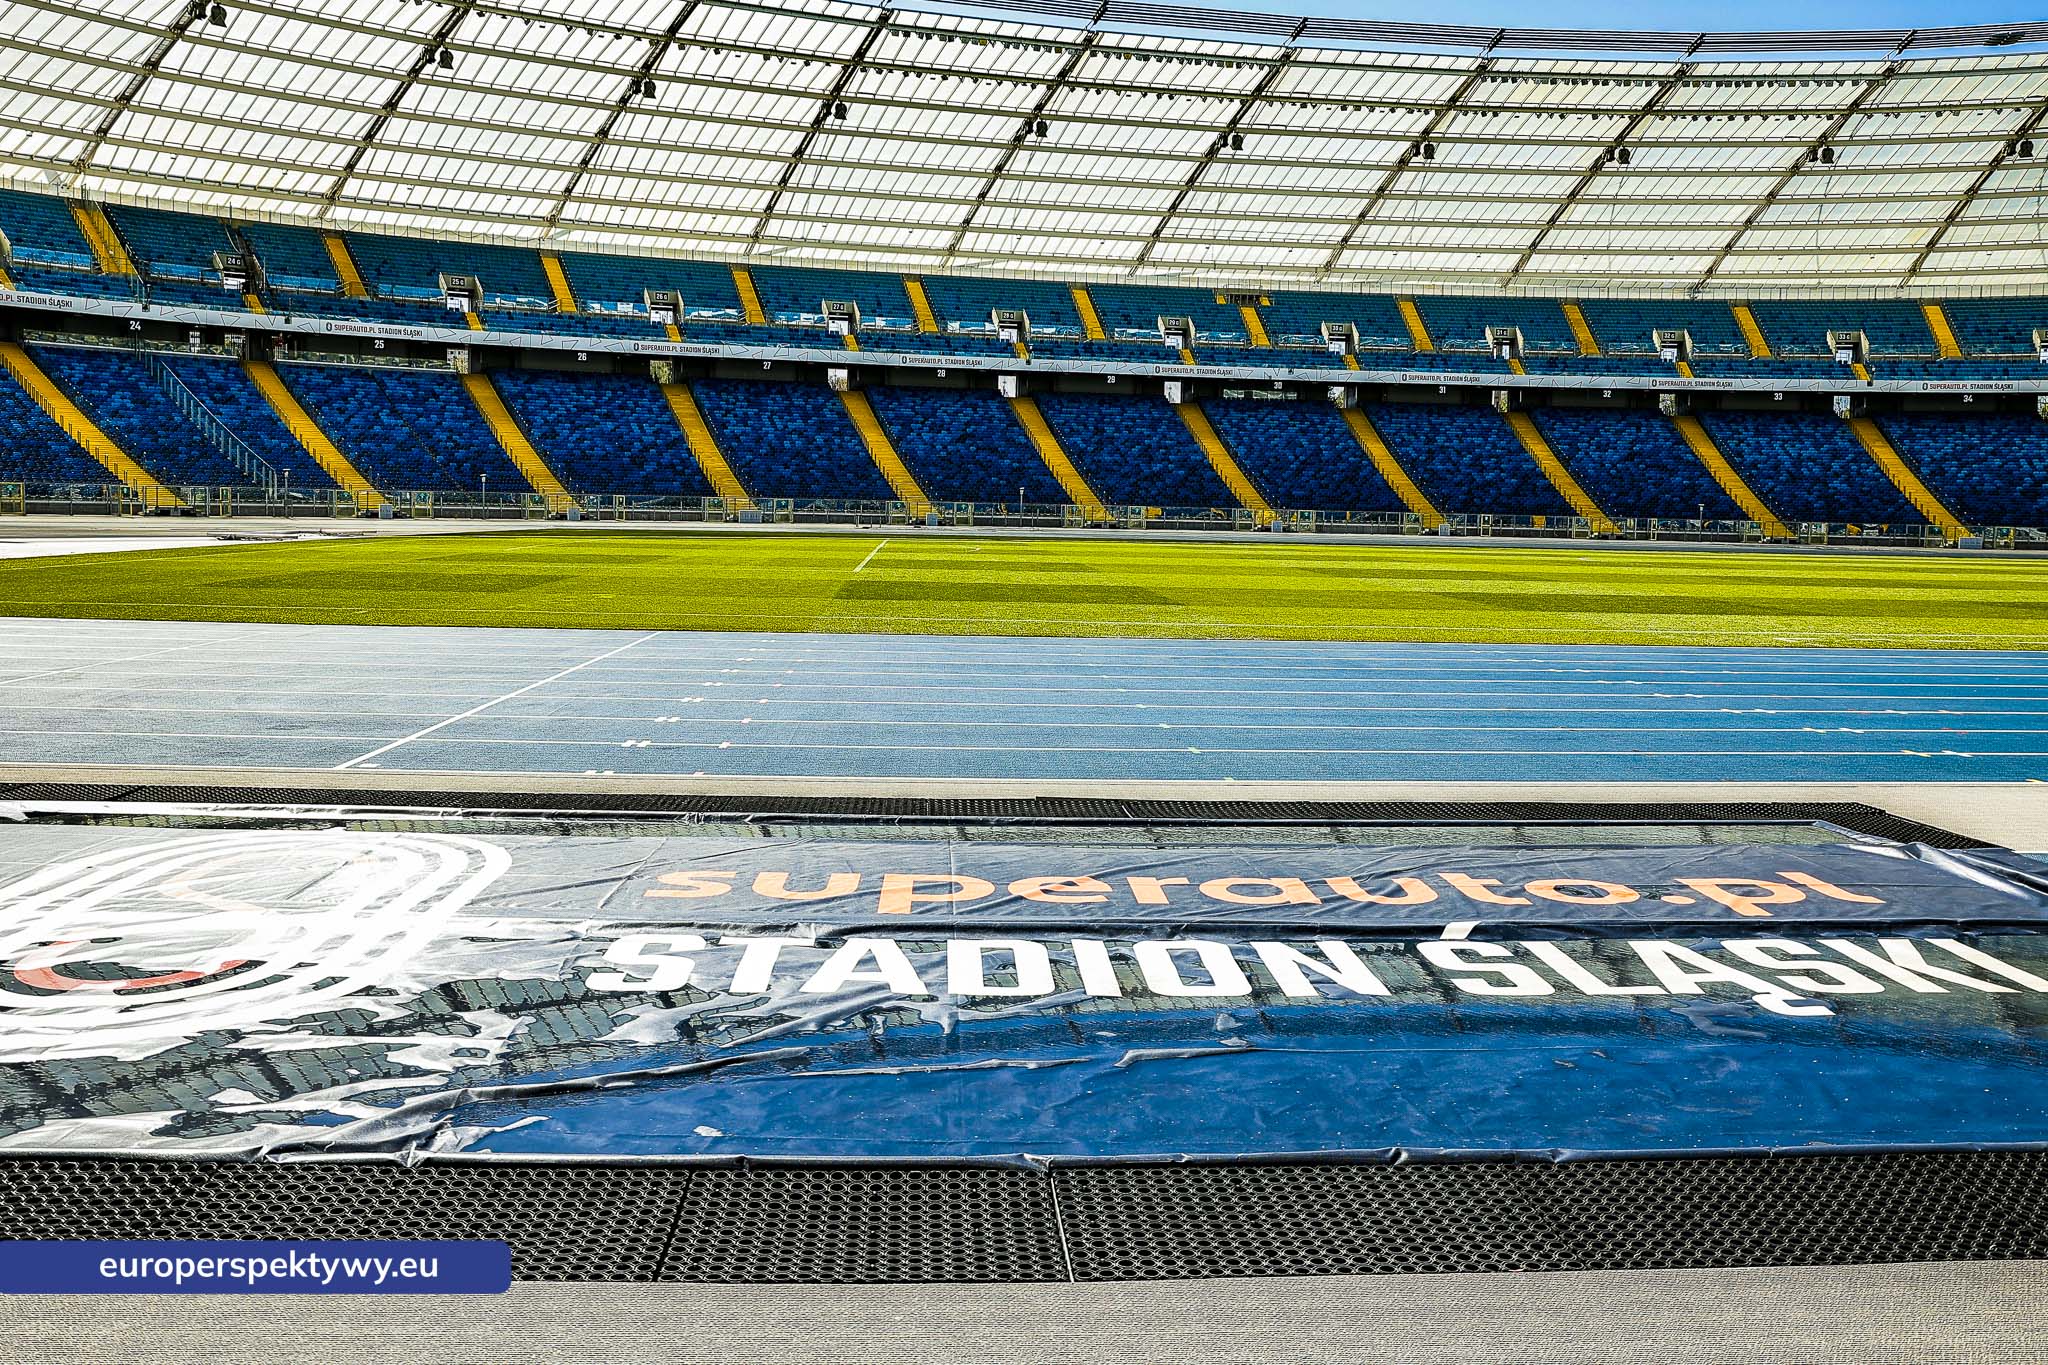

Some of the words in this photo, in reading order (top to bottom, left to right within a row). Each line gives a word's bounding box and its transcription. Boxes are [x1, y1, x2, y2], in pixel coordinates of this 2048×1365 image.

[16, 296, 47, 304] STADION
[48, 297, 72, 308] ŚLĄSKI
[130, 320, 141, 330] 24
[334, 324, 376, 334] SUPERAUTO.PL
[402, 328, 423, 338] ŚLĄSKI
[374, 340, 384, 349] 25
[640, 344, 678, 352] SUPERAUTO.PL
[702, 347, 720, 355] ŚLĄSKI
[763, 362, 771, 370] 27
[908, 356, 944, 364] SUPERAUTO.PL
[966, 359, 982, 368] ŚLĄSKI
[937, 369, 946, 377] 28
[1993, 383, 2014, 392] ŚLĄSKI
[645, 870, 1884, 915] superauto.pl
[585, 935, 1391, 997] STADION
[1417, 921, 2048, 1016] ŚLĄSKI
